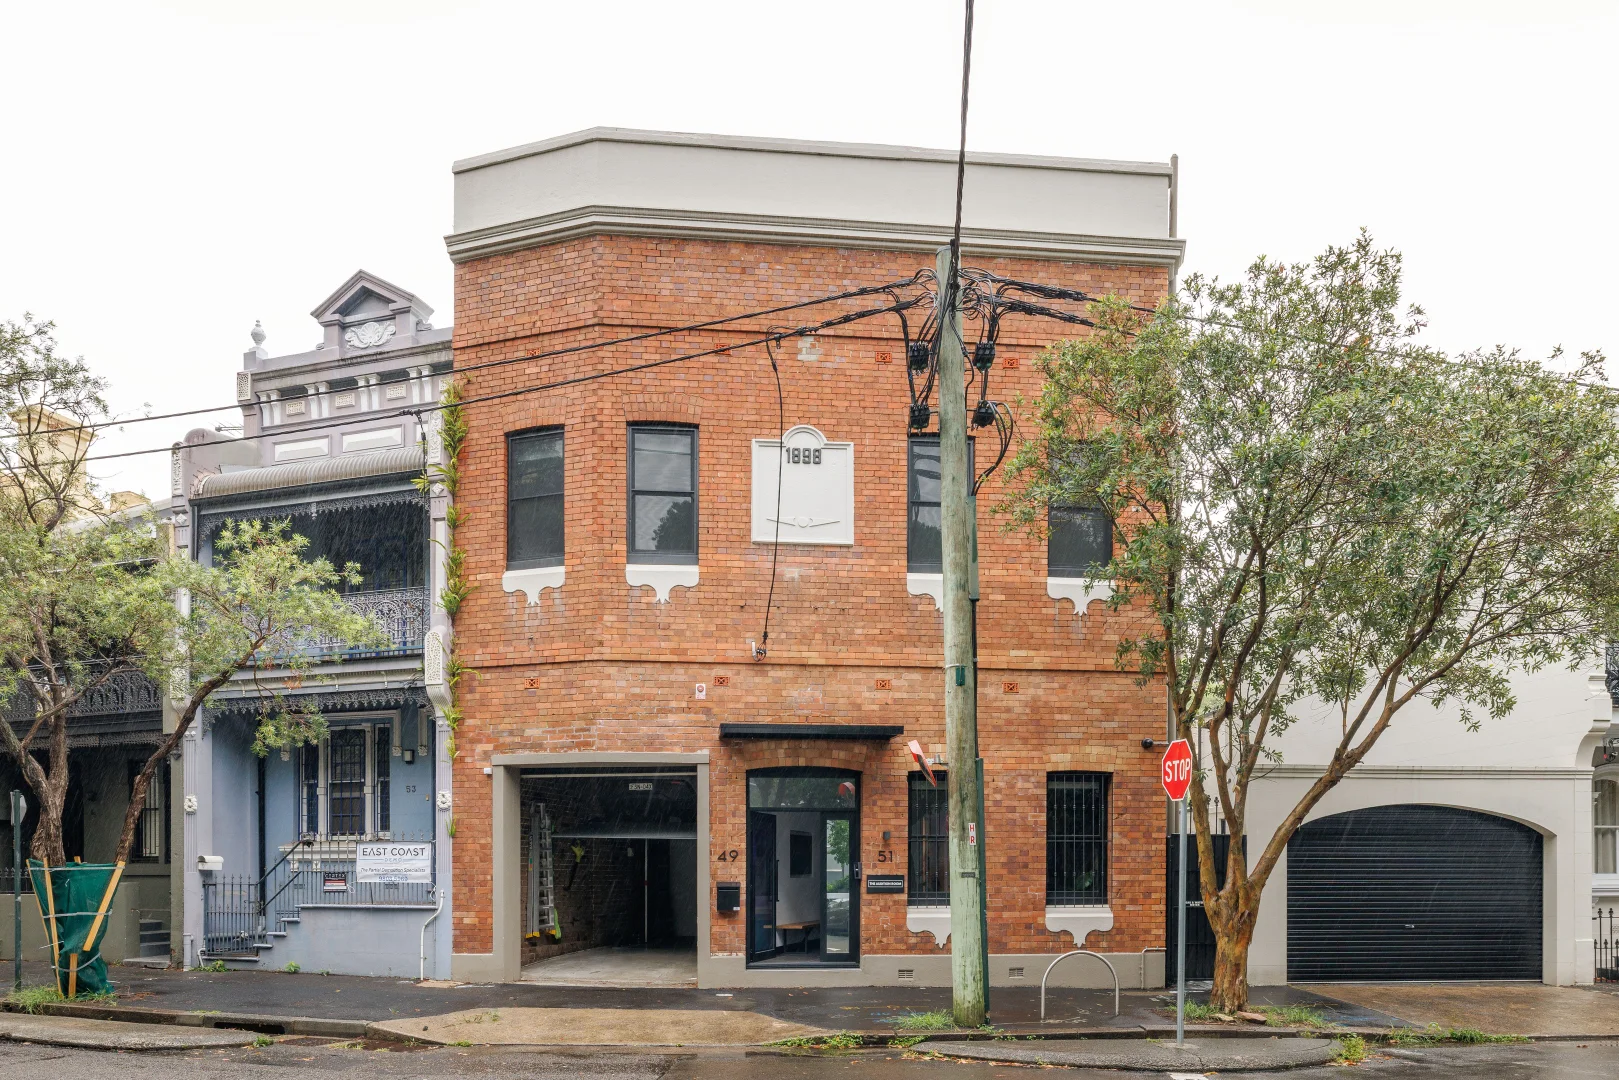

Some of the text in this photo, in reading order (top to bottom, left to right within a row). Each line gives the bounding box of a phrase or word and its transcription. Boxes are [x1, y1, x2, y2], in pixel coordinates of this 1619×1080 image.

[786, 447, 822, 464] 1898
[1165, 758, 1190, 782] STOP
[405, 785, 417, 793] 53
[970, 824, 975, 832] H
[970, 835, 975, 844] R
[362, 847, 426, 856] EAST COAST
[717, 849, 739, 863] 49
[878, 850, 893, 863] 51
